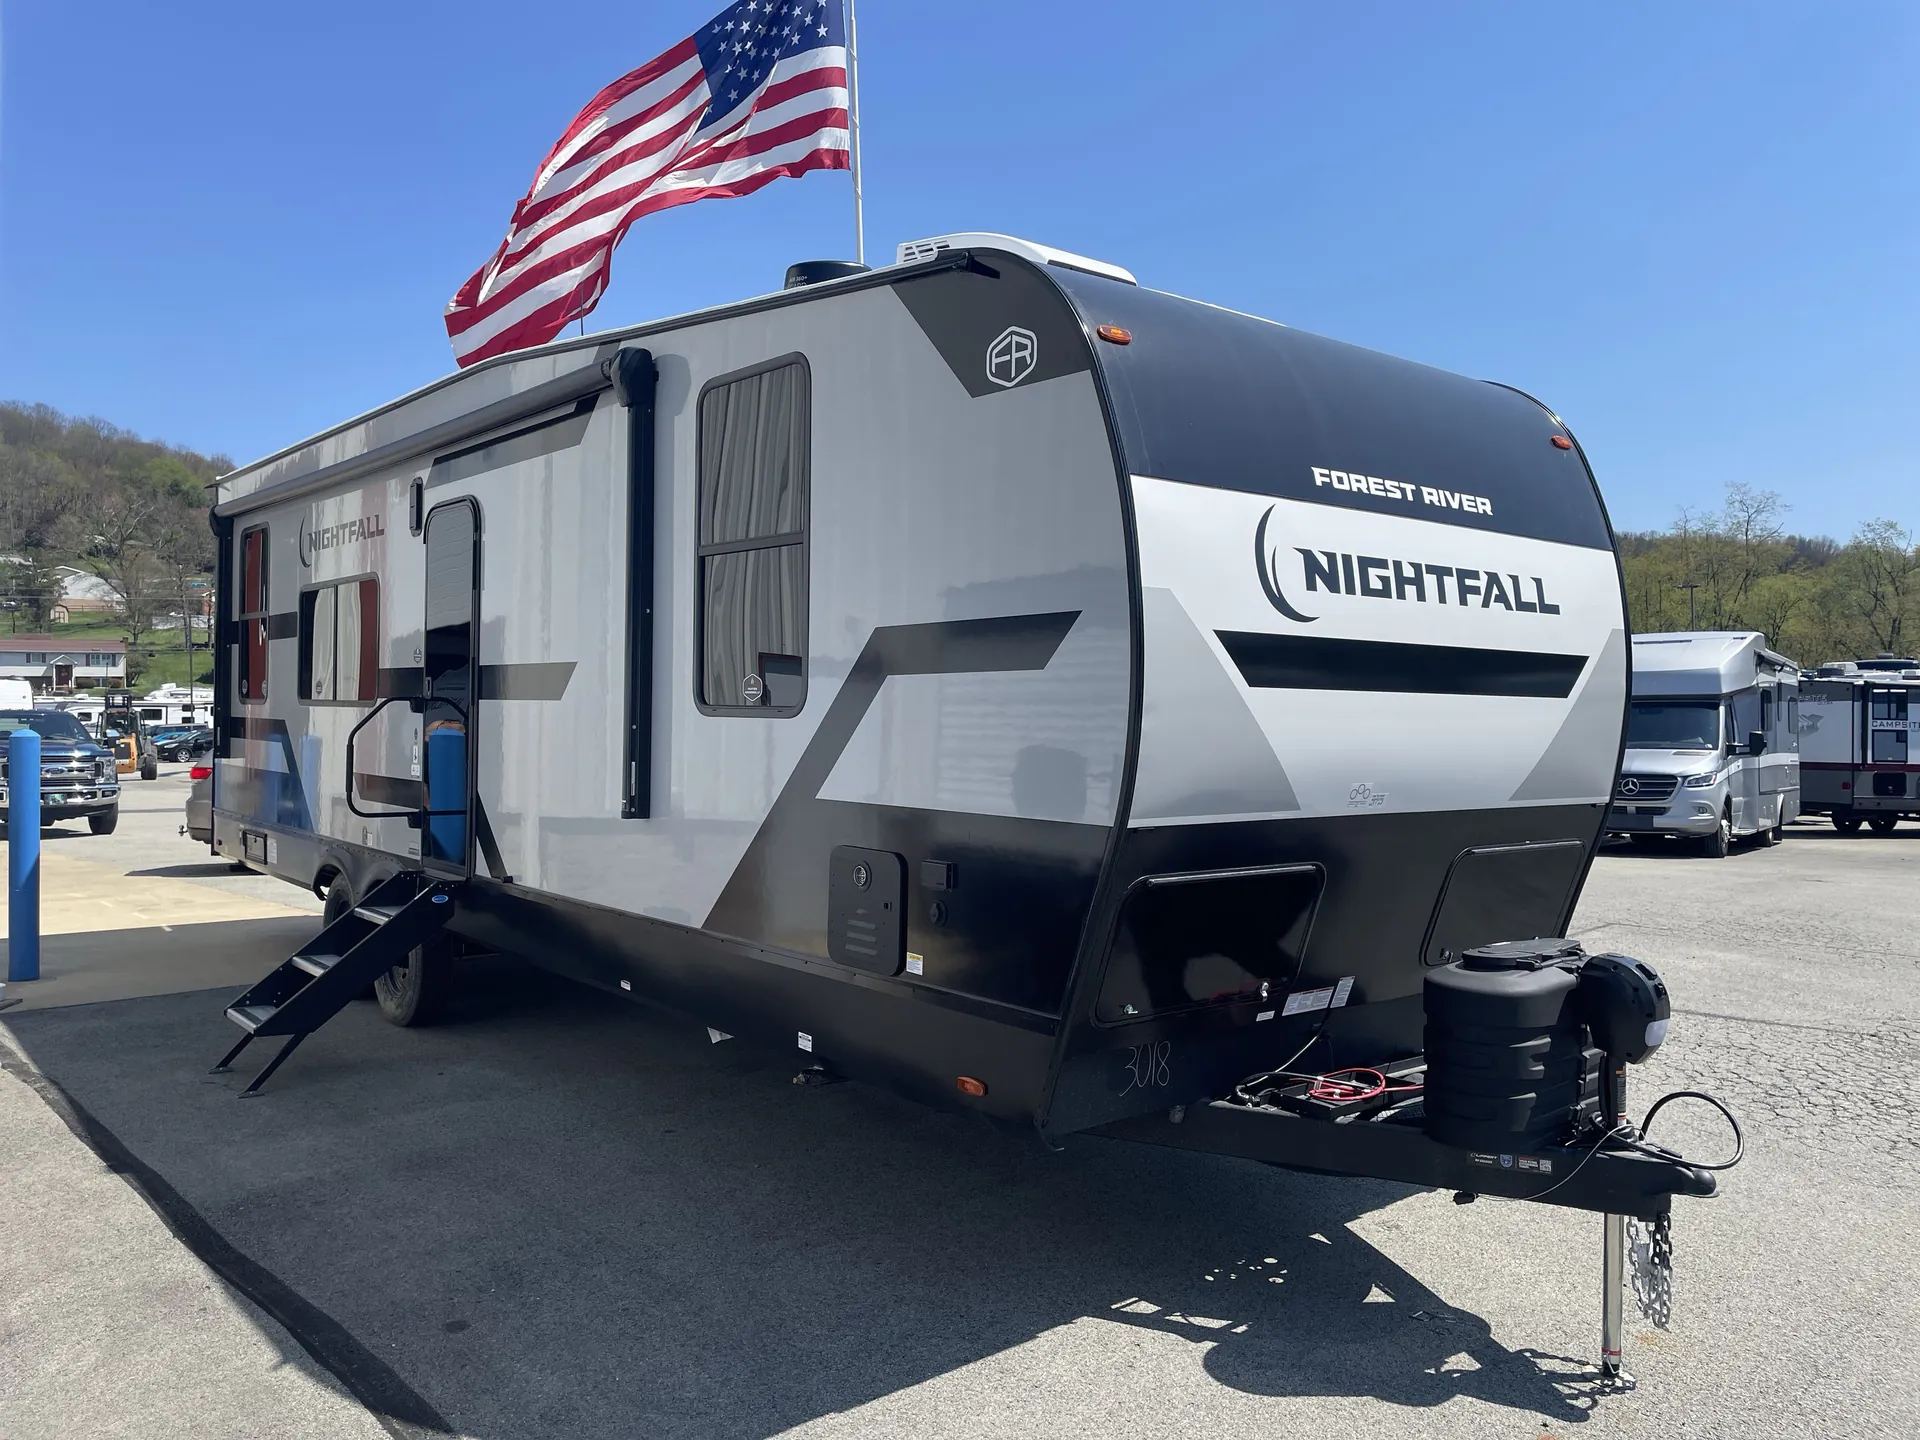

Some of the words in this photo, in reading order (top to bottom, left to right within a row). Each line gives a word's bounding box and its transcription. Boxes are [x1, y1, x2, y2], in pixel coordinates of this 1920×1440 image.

[1310, 466, 1416, 501] FOREST
[1419, 485, 1494, 516] RIVER
[308, 514, 385, 553] NIGHTFALL
[1292, 547, 1561, 615] NIGHTFALL
[1118, 1040, 1171, 1097] 3018
